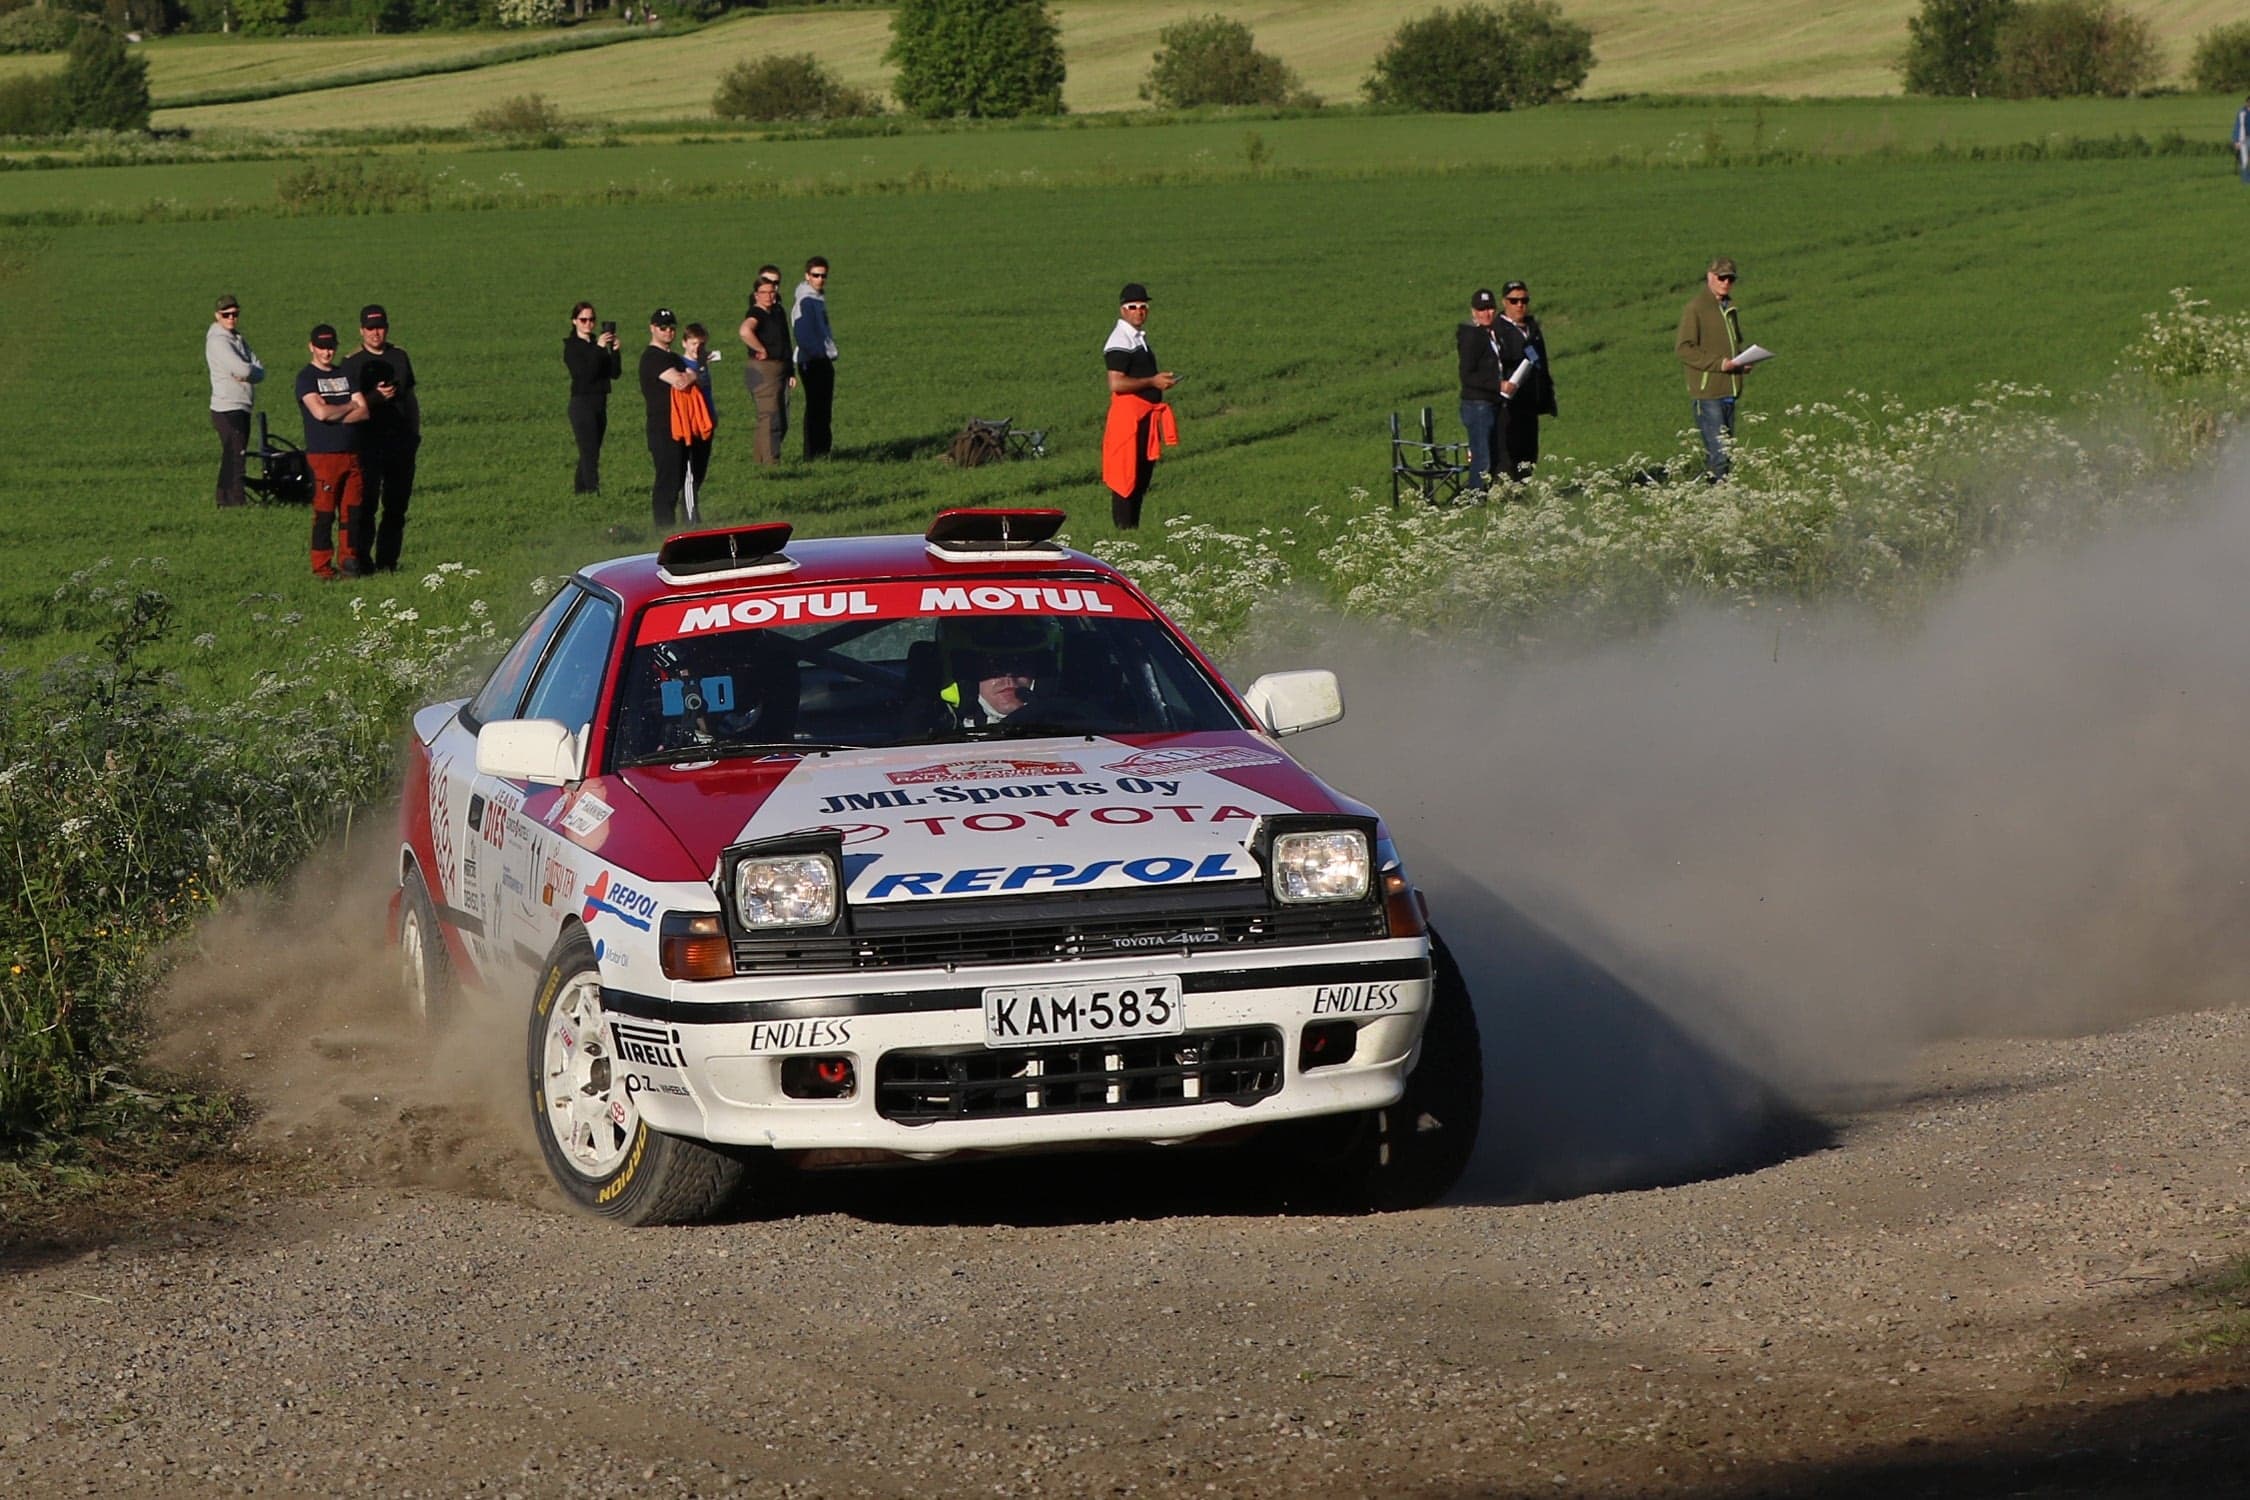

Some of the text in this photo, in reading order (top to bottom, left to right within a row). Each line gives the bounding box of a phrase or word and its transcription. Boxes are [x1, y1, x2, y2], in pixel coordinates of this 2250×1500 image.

[678, 586, 1113, 634] MOTUL MOTUL
[820, 774, 1182, 814] JML-Sports Oy
[904, 804, 1257, 836] TOYOTA
[866, 853, 1239, 899] REPSOL
[608, 882, 658, 919] REPSOL
[1112, 932, 1219, 948] TOYOTA 4WD
[996, 987, 1171, 1036] KAM-583
[1312, 983, 1399, 1014] ENDLESS
[610, 1022, 688, 1068] PIRELLI
[750, 1019, 852, 1051] ENDLESS
[597, 1121, 647, 1204] ORPION
